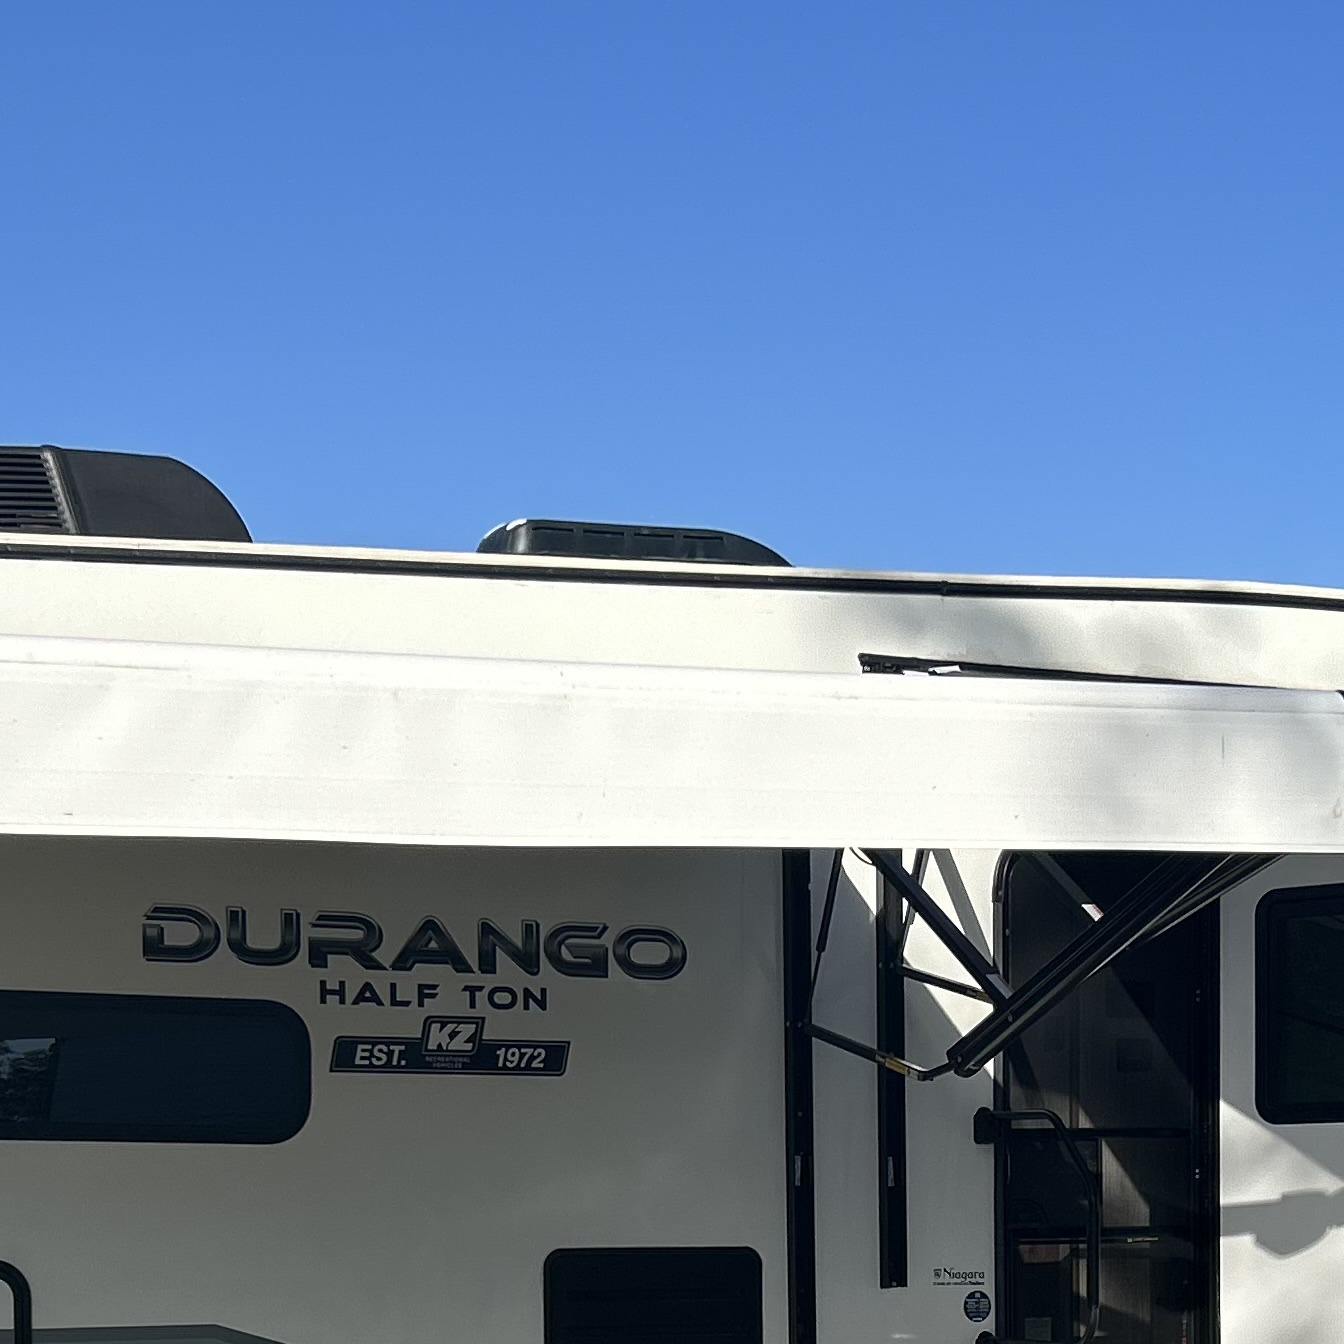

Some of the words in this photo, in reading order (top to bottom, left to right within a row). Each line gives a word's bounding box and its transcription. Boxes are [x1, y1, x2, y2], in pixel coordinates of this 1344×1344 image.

[142, 903, 687, 980] DURANGO
[319, 980, 440, 1008] HALF
[462, 985, 548, 1011] TON
[427, 1023, 476, 1051] KZ
[354, 1045, 406, 1067] EST.
[495, 1047, 545, 1068] 1972
[943, 1268, 985, 1281] Niagara
